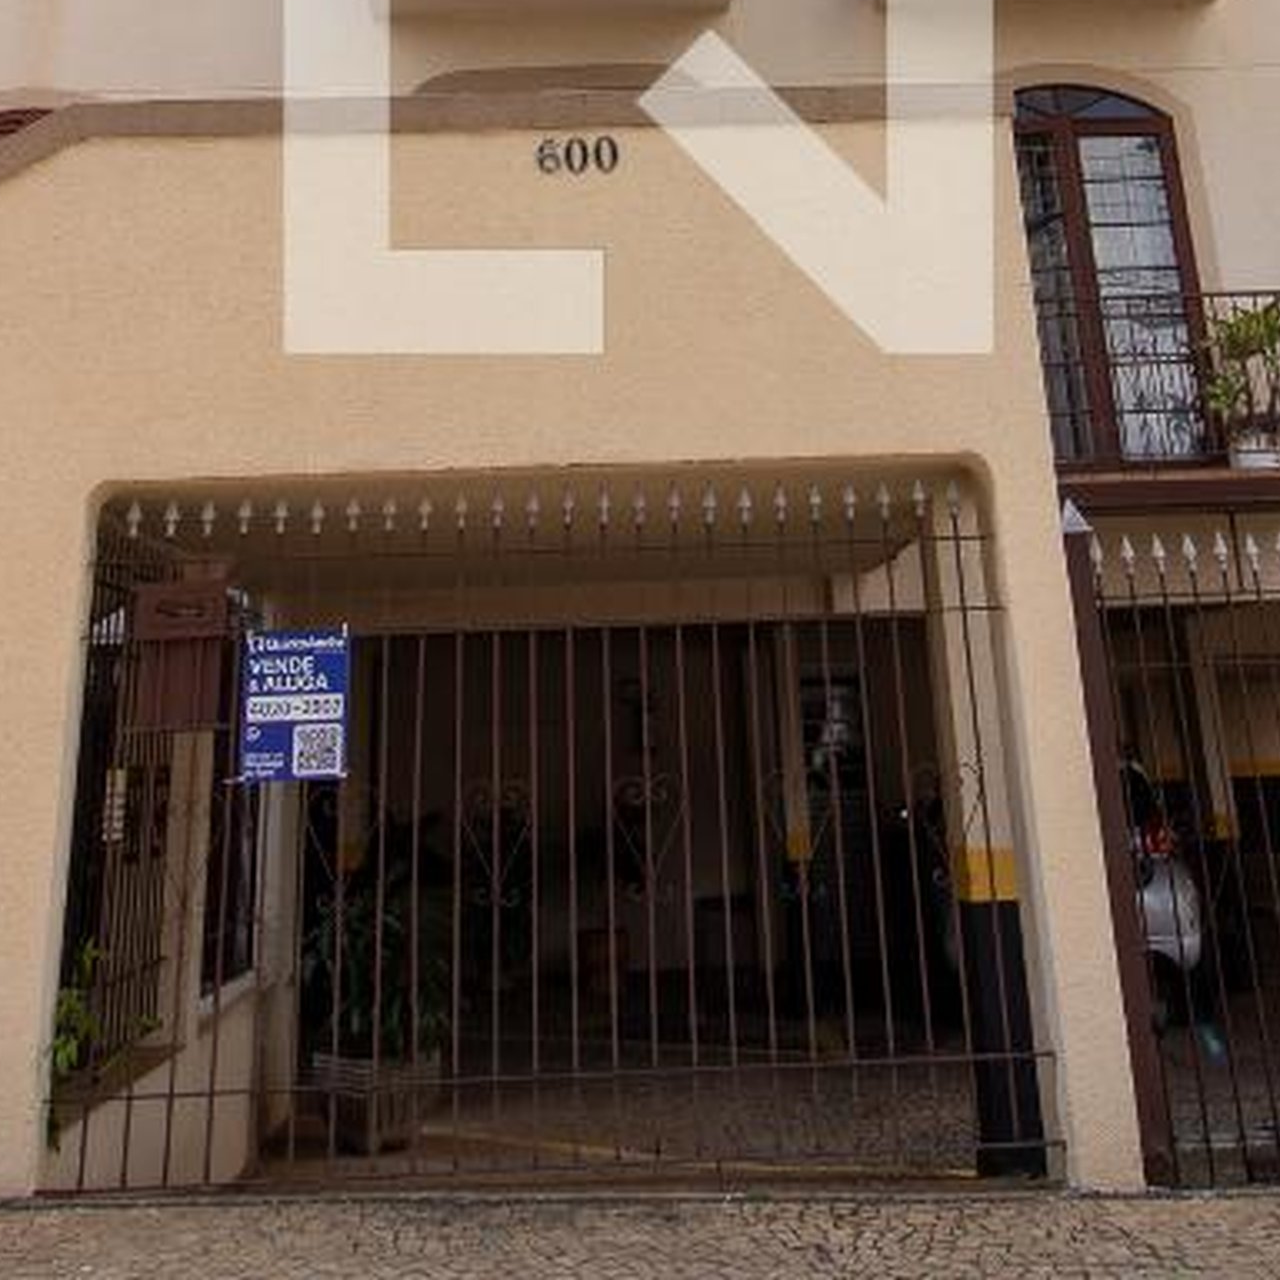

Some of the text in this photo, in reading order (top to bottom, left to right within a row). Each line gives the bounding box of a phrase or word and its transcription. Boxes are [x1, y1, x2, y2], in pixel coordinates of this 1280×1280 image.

[536, 135, 619, 175] 600
[248, 656, 315, 674] VENDE
[263, 674, 329, 692] ALUGA
